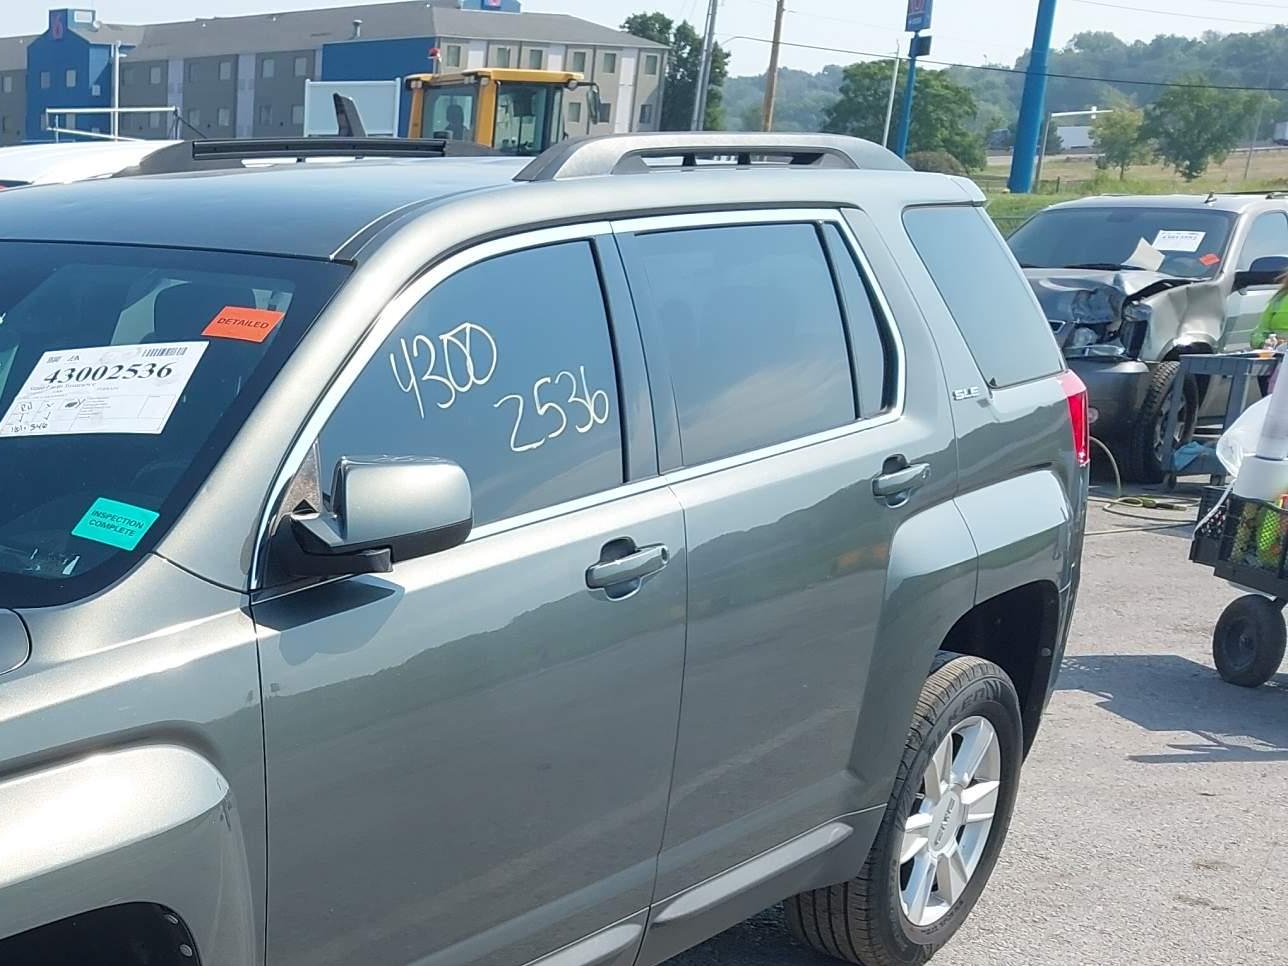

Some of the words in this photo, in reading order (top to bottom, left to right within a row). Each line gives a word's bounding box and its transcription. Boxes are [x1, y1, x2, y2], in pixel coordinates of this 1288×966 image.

[216, 317, 270, 329] DETAILED
[43, 361, 173, 384] 43002536
[390, 322, 497, 419] 4300
[953, 386, 979, 401] SLE
[493, 365, 609, 452] 2536
[88, 519, 137, 537] COMPLETE
[91, 510, 145, 529] INSPECTION
